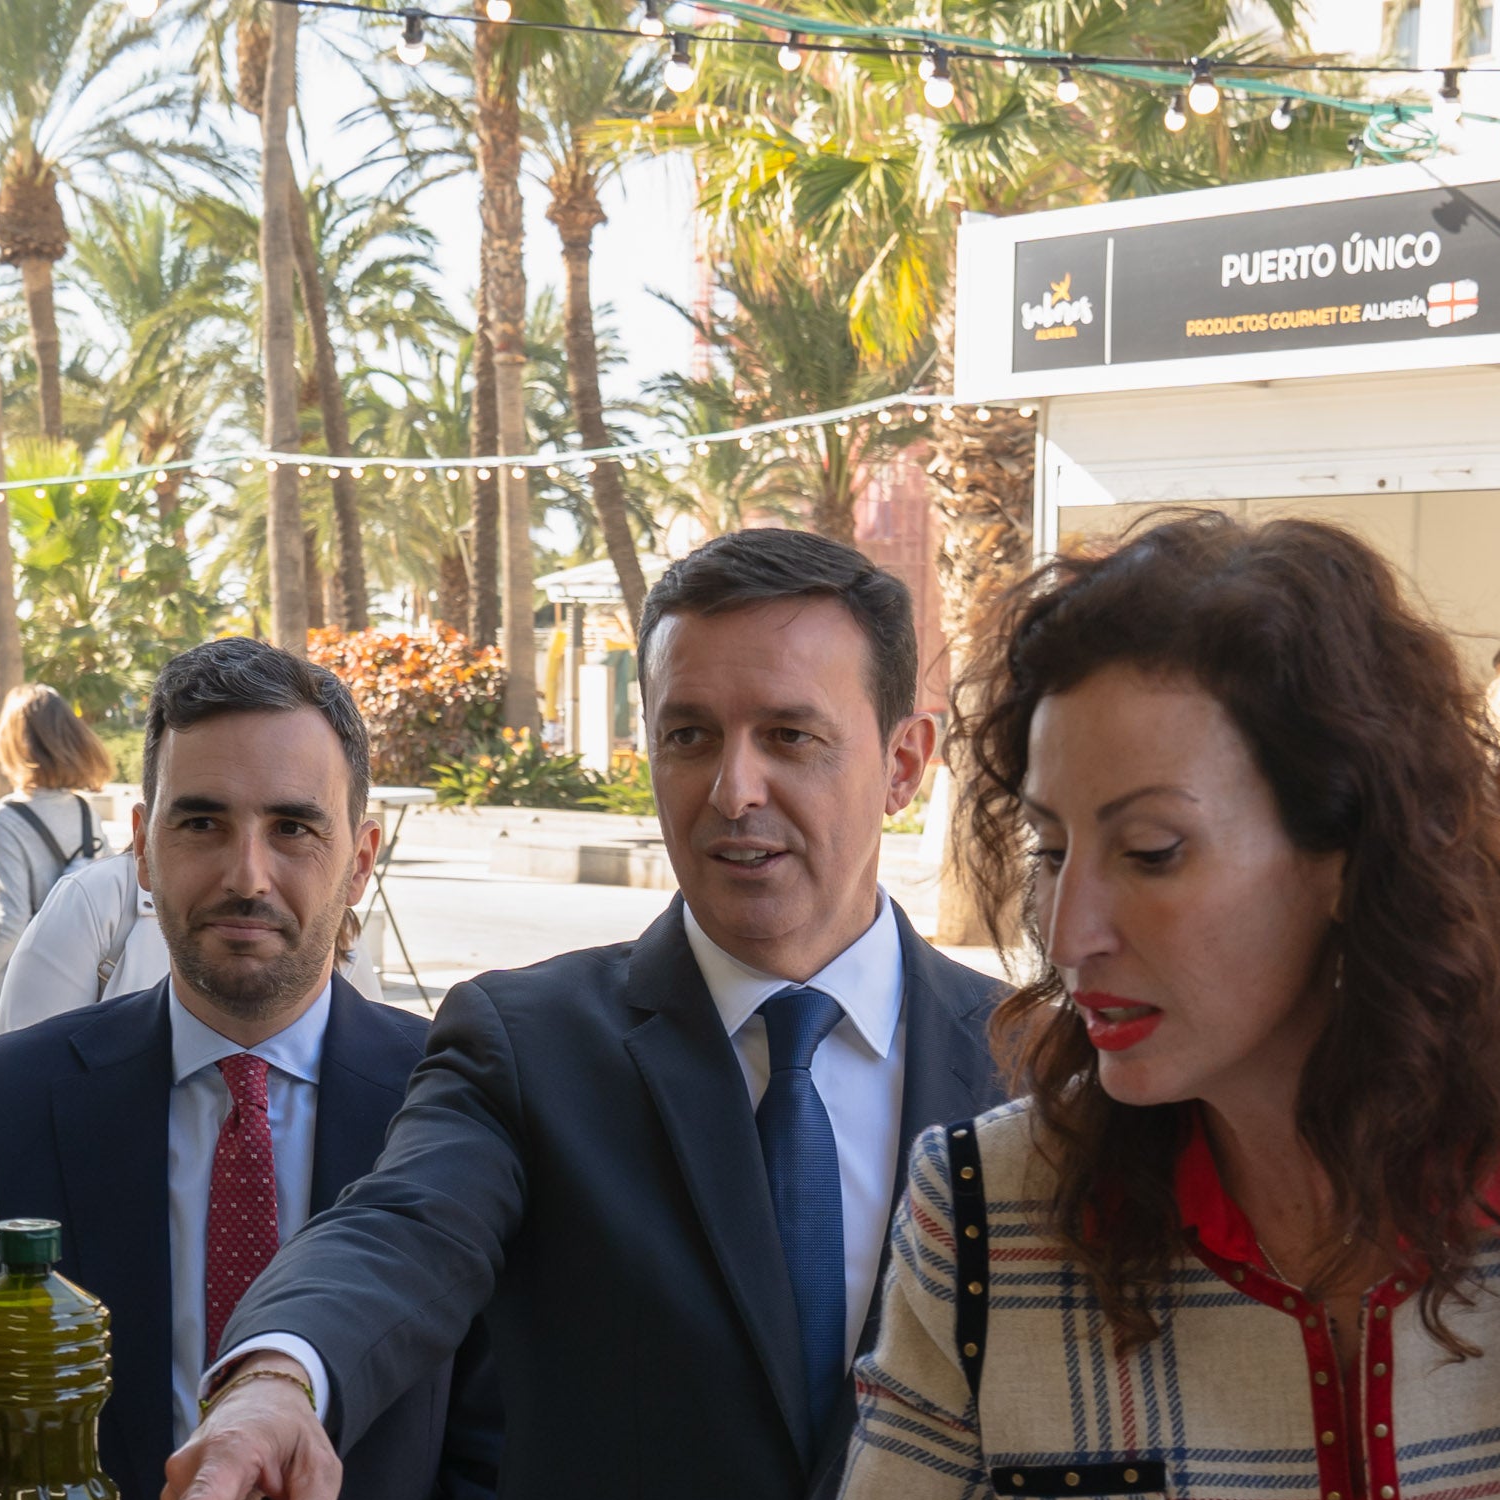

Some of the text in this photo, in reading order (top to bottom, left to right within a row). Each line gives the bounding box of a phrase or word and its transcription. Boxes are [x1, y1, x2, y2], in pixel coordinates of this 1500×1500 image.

[1221, 231, 1441, 288] PUERTO ÚNICO
[1186, 295, 1427, 338] PRODUCTOS GOURMET DE ALMERÍA
